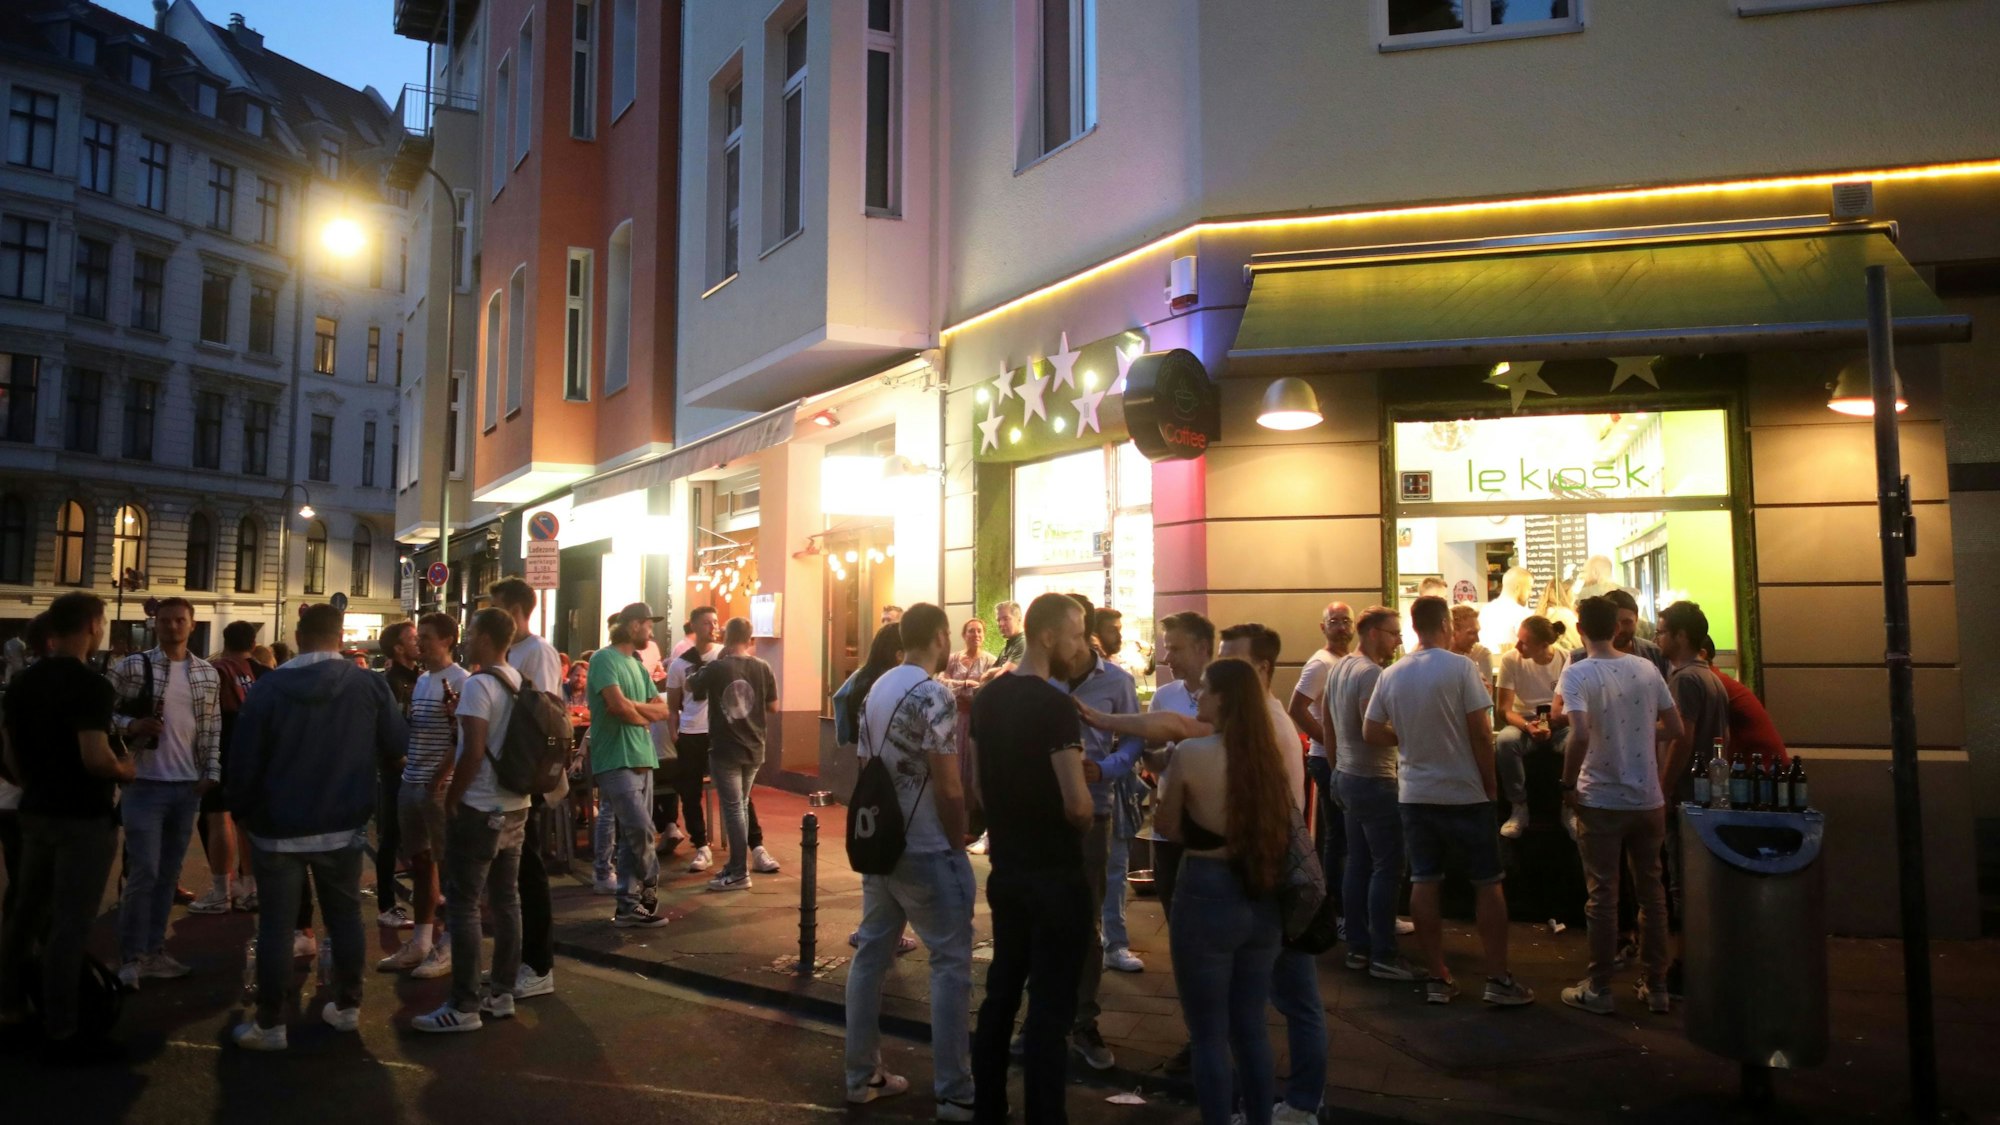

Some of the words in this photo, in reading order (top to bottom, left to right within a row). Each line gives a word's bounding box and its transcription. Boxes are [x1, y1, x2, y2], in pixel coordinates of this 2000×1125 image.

[1164, 423, 1207, 449] Coffee
[1468, 459, 1507, 493] le
[1520, 454, 1650, 491] kiosk
